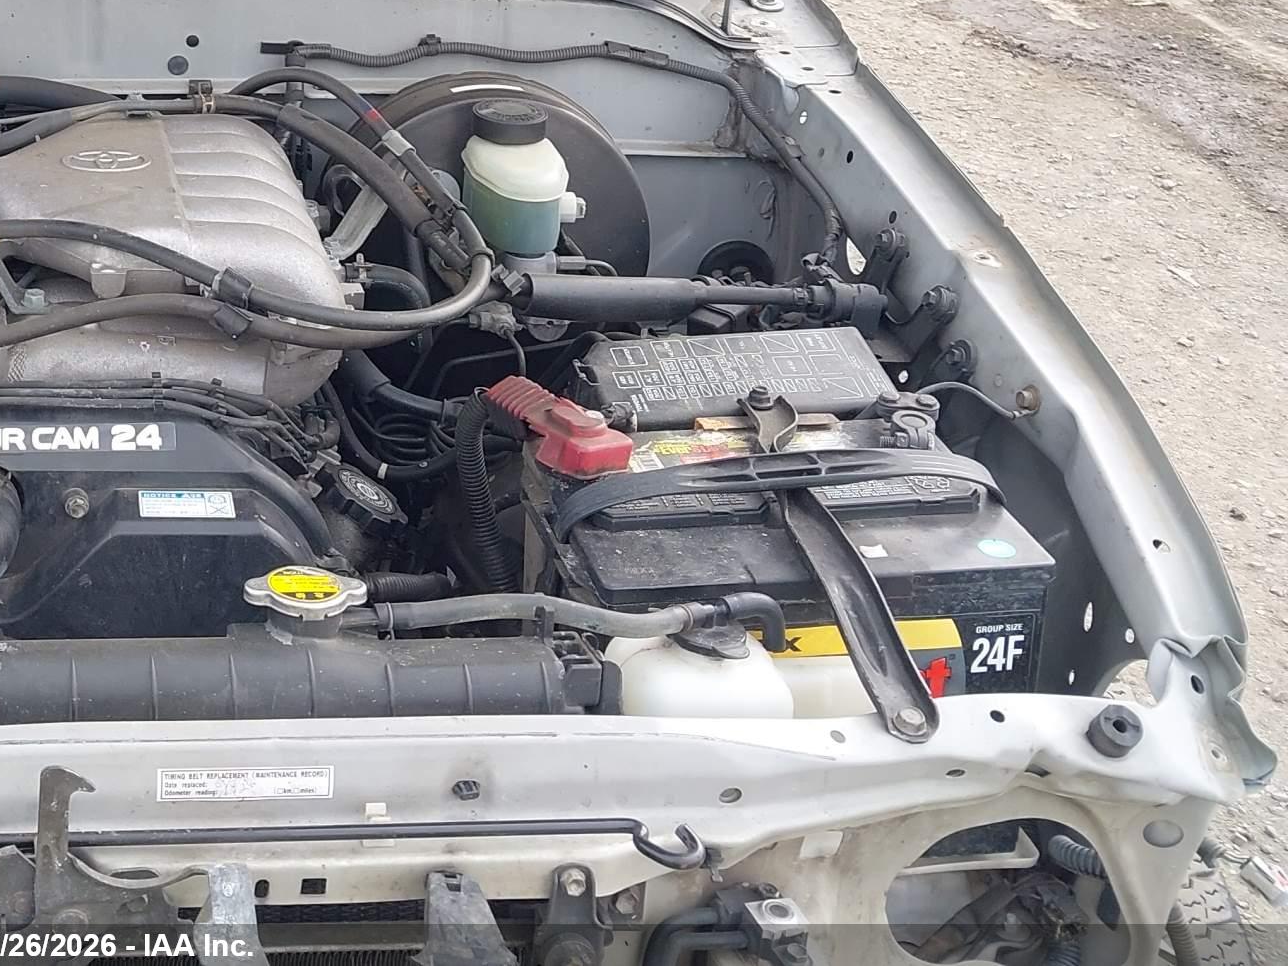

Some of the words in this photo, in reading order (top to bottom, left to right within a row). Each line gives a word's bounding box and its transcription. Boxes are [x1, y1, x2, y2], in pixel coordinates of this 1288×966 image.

[31, 425, 100, 451] CAM
[111, 423, 163, 451] 24
[975, 624, 1004, 634] GROUP
[1005, 623, 1025, 632] SIZE
[970, 635, 1025, 673] 24F
[188, 772, 203, 780] BELT
